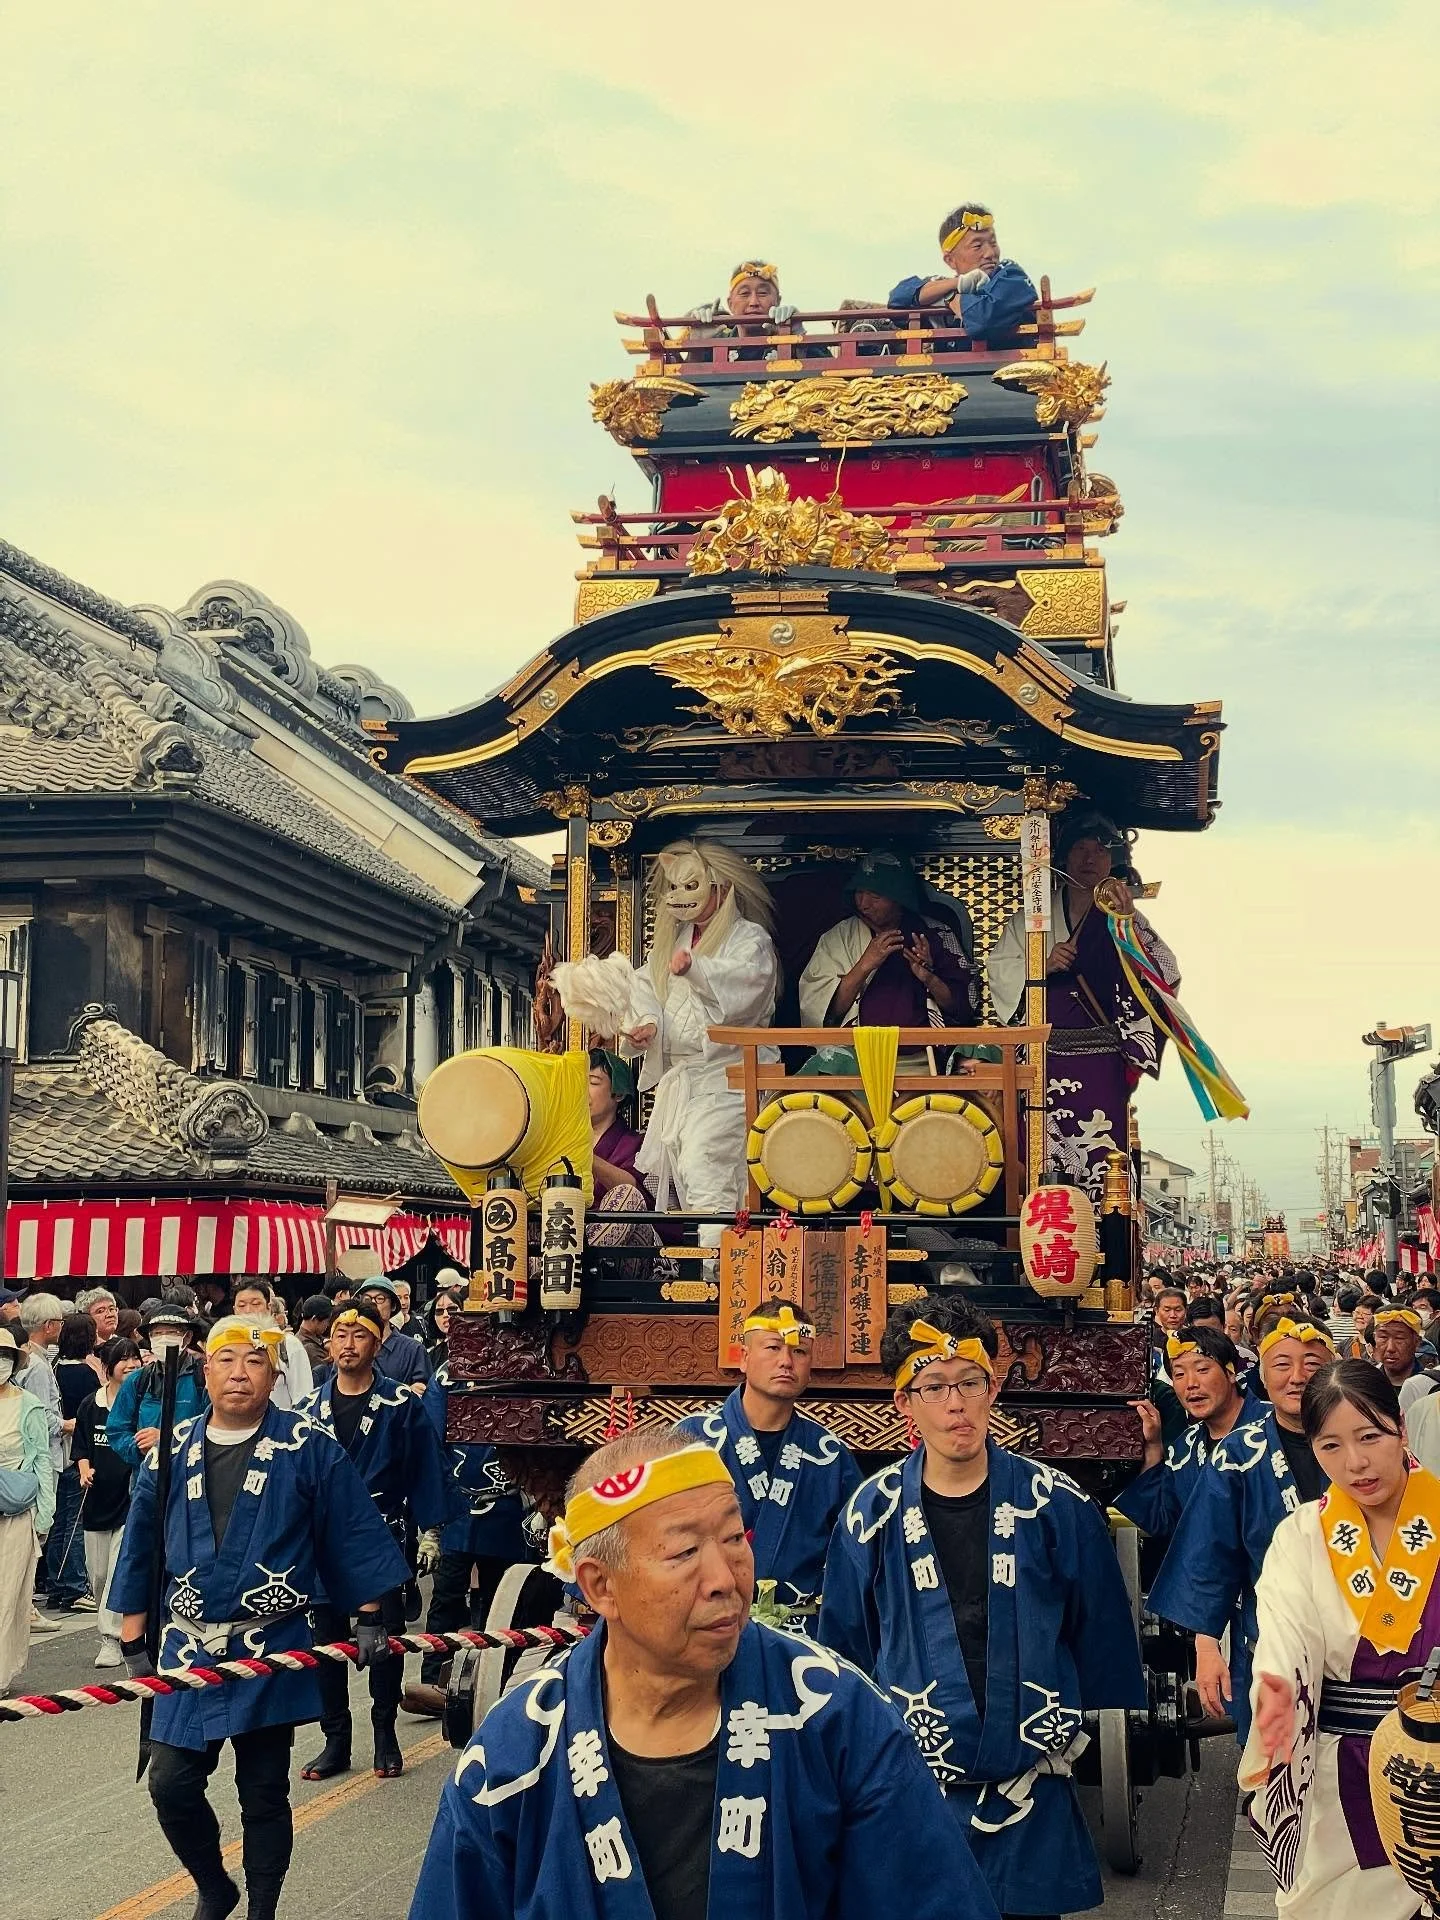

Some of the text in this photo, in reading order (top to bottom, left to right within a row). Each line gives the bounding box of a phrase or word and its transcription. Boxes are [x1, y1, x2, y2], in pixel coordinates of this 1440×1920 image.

[543, 1201, 577, 1295] 森田
[766, 1247, 788, 1297] 翁の
[1026, 1188, 1080, 1285] 堤崎
[849, 1244, 873, 1356] 幸町囃子連
[242, 1436, 276, 1496] 幸町
[735, 1435, 769, 1501] 幸町
[768, 1442, 803, 1507] 幸町
[903, 1505, 940, 1592] 幸町
[991, 1501, 1016, 1588] 幸町
[1332, 1522, 1376, 1595] 幸町
[1389, 1517, 1433, 1597] 幸町
[567, 1727, 633, 1884] 幸町
[717, 1700, 771, 1859] 幸町
